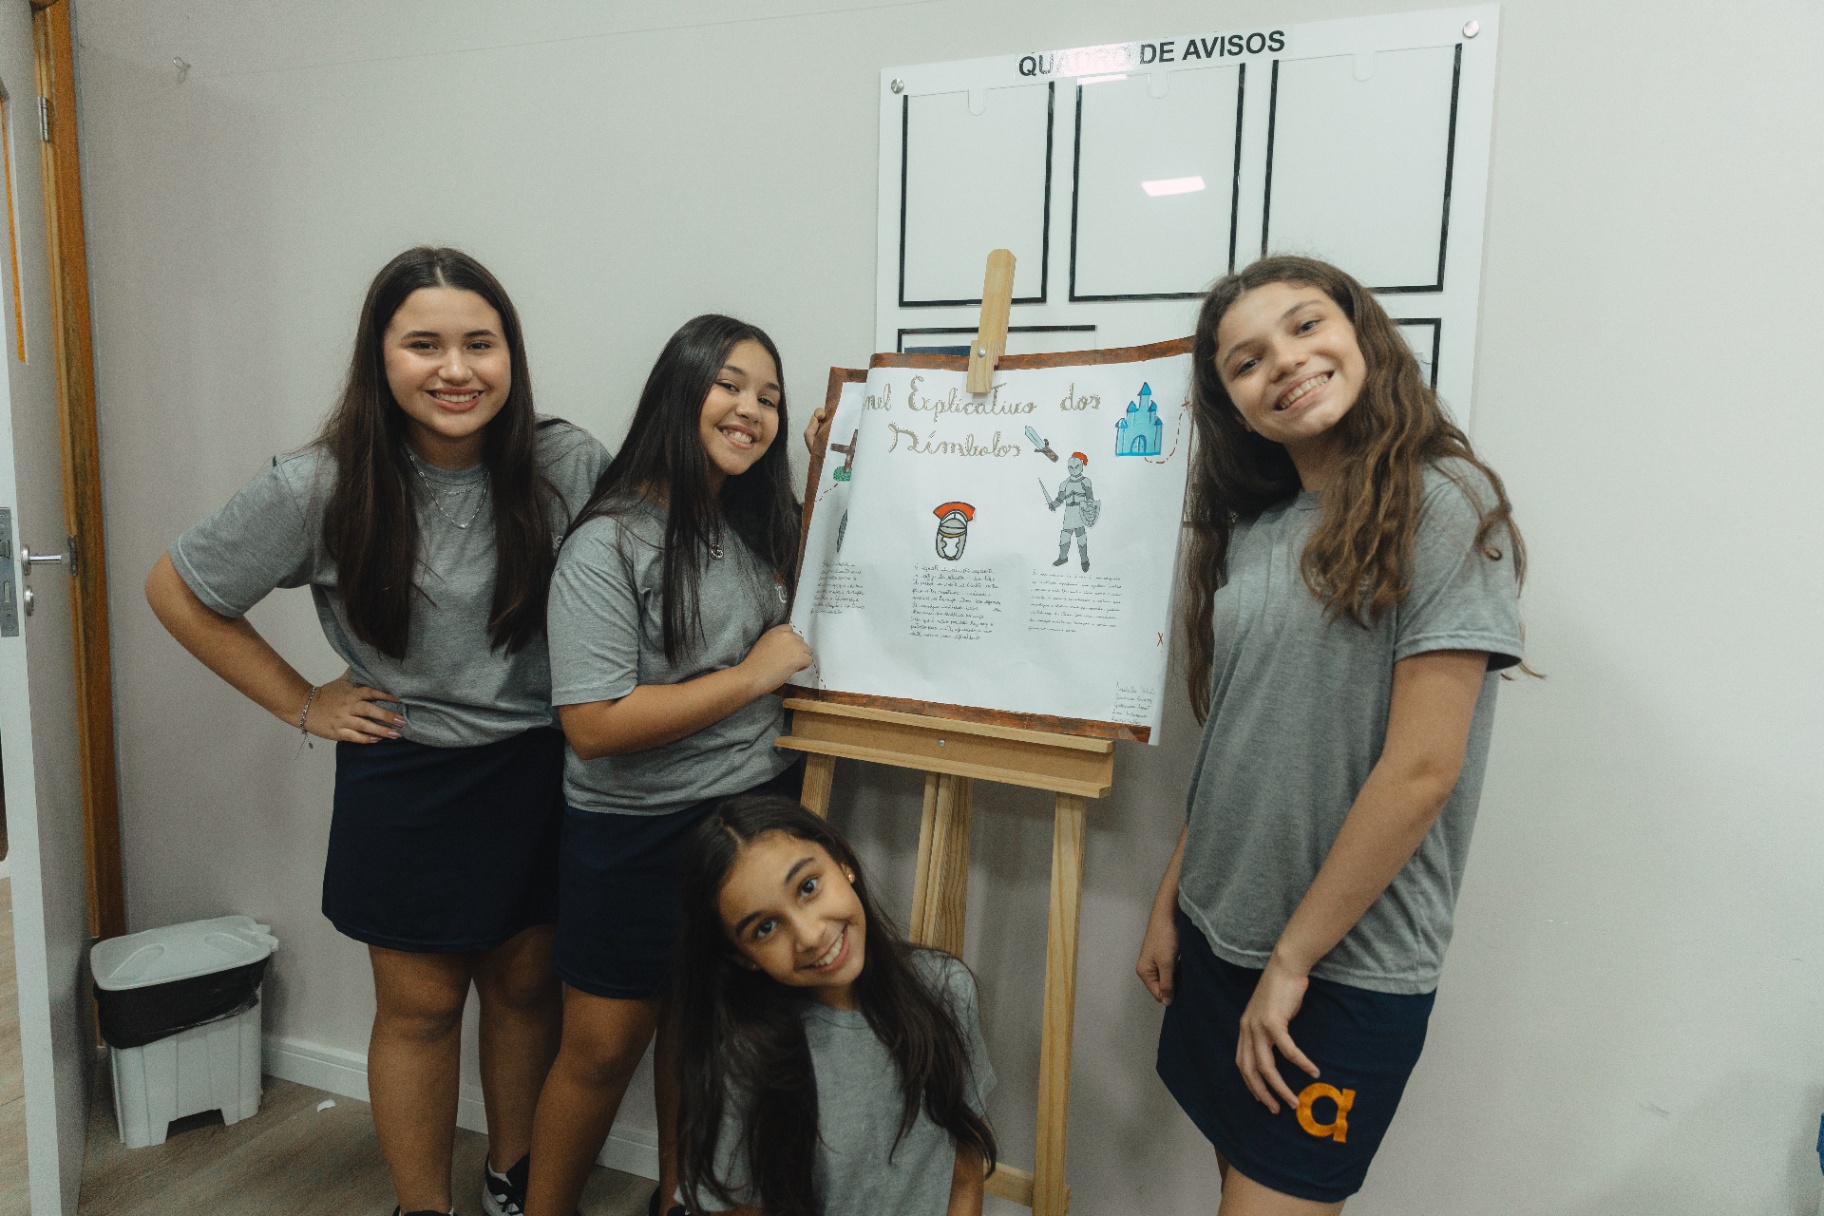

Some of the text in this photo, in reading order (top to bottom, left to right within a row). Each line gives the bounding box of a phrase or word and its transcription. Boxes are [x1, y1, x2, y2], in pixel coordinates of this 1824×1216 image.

[1139, 41, 1176, 65] DE
[1181, 30, 1286, 61] AVISOS
[1060, 382, 1102, 412] dos
[887, 421, 1023, 458] Símbolos
